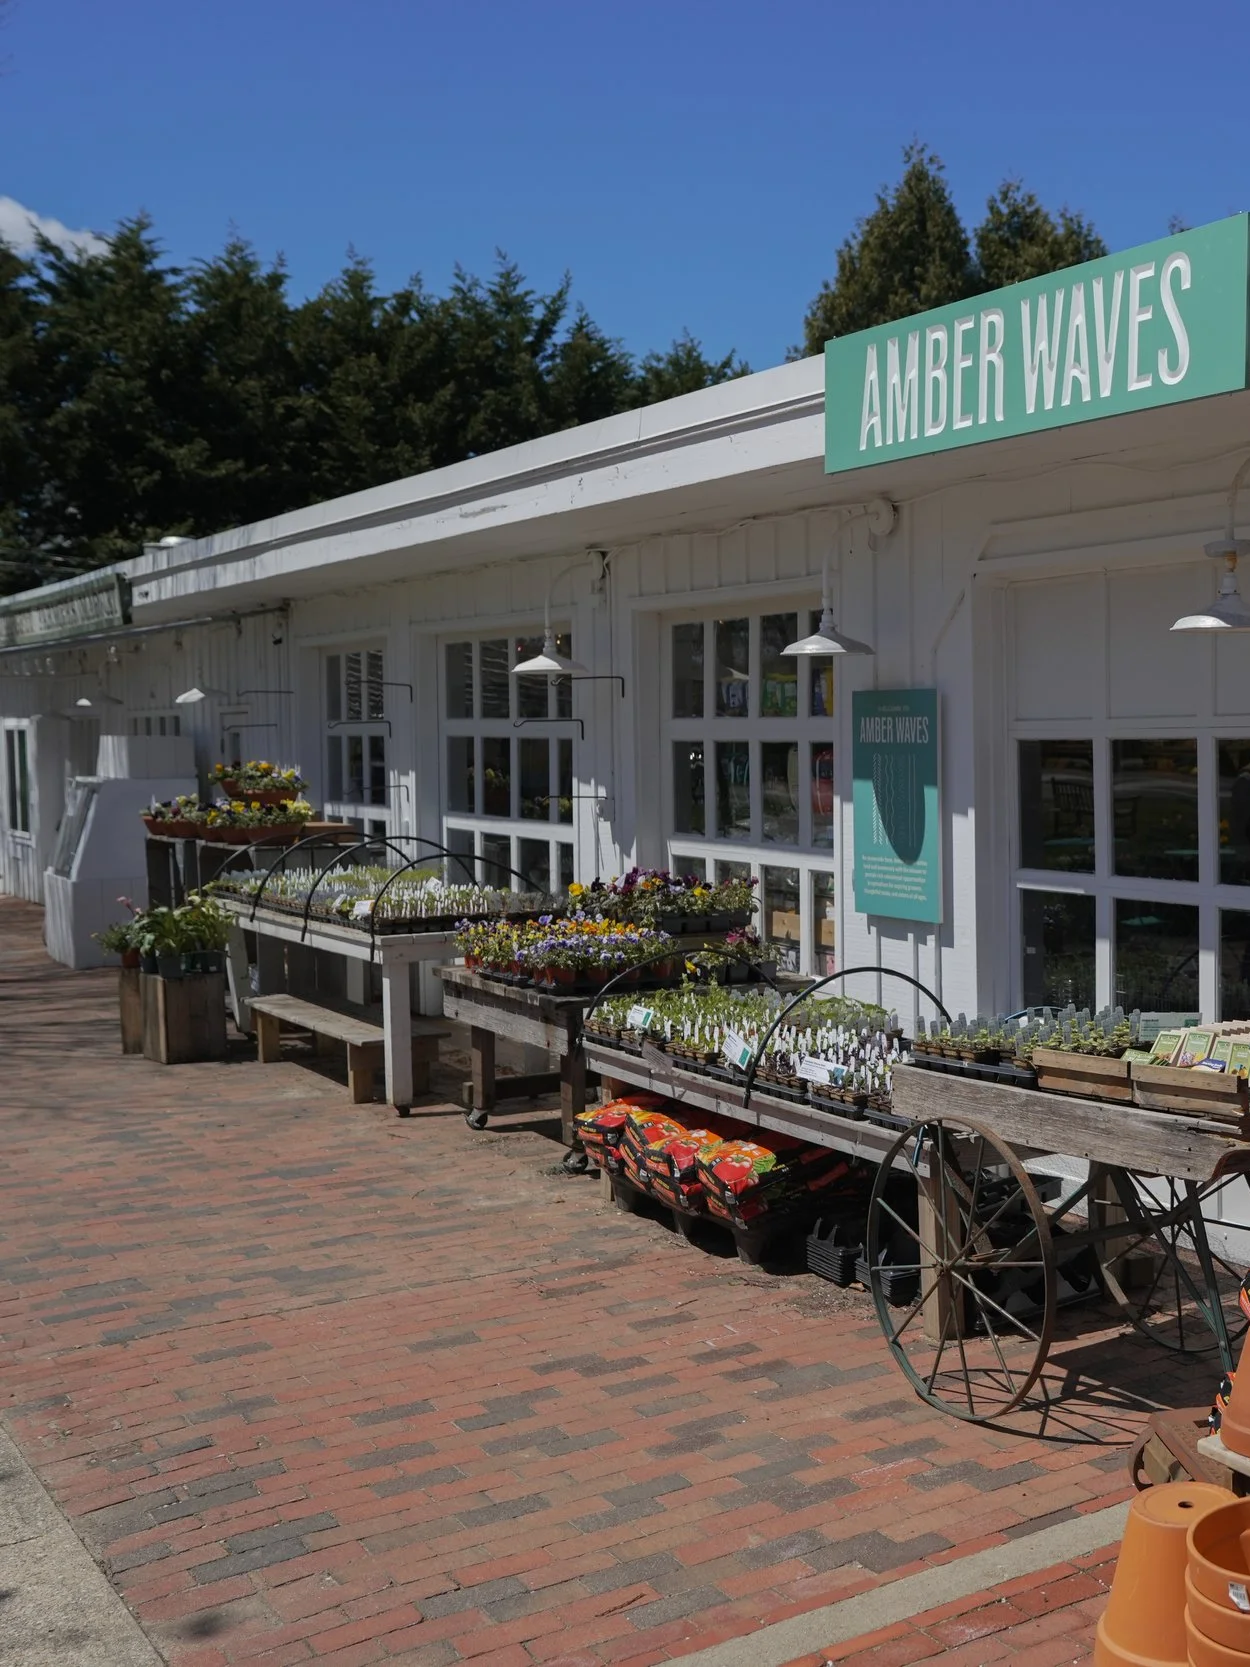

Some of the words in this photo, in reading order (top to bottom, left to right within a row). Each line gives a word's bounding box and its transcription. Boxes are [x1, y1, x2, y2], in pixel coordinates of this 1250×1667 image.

[859, 307, 1005, 451] AMBER
[1020, 251, 1192, 415] WAVES
[859, 716, 894, 744] AMBER
[895, 716, 929, 744] WAVES
